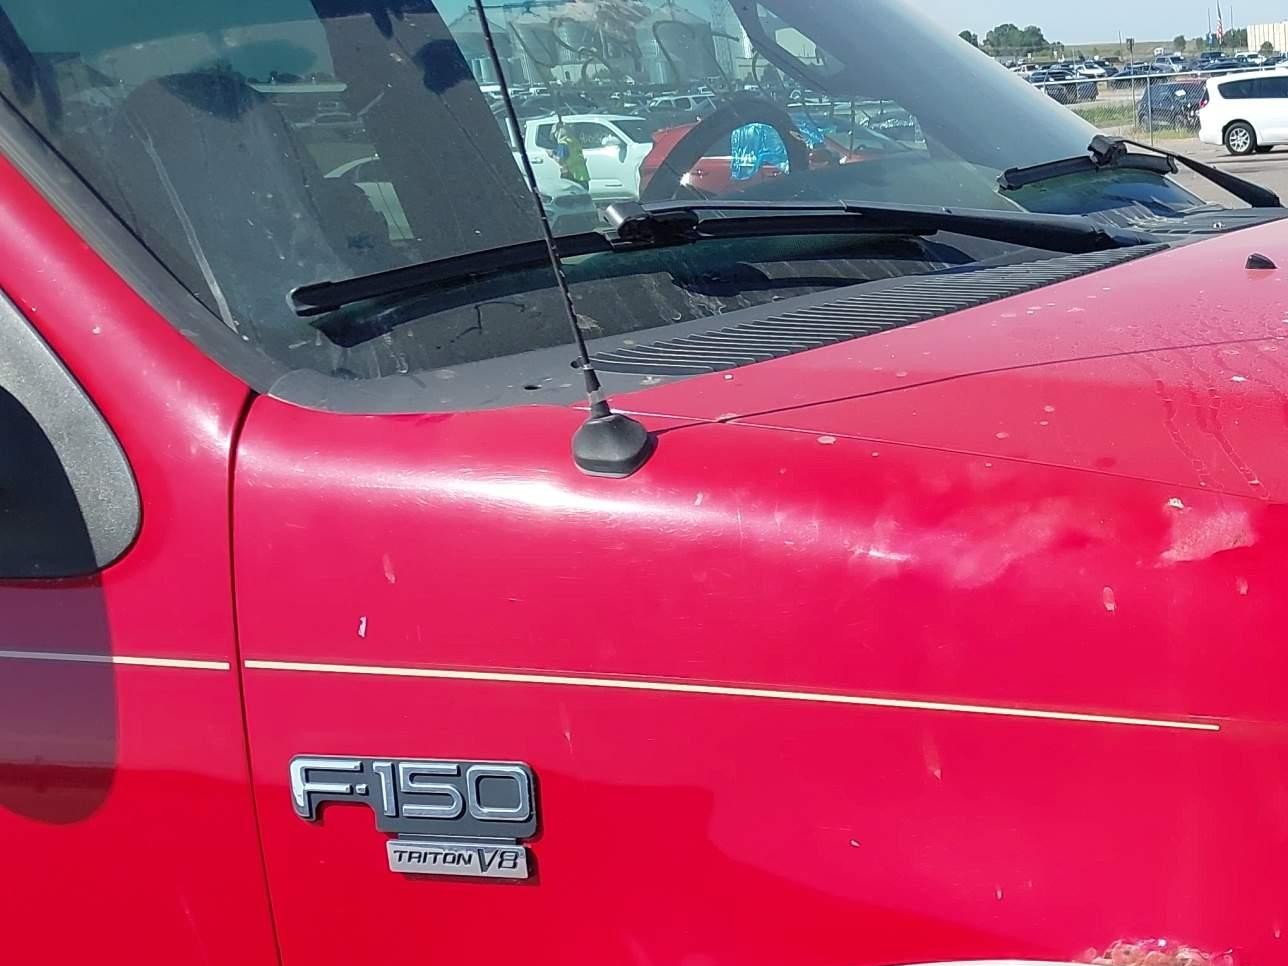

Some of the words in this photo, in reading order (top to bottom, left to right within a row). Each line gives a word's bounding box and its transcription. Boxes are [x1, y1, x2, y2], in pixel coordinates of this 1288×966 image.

[290, 760, 531, 822] F-150
[393, 849, 473, 867] TRITON
[477, 848, 519, 873] V8
